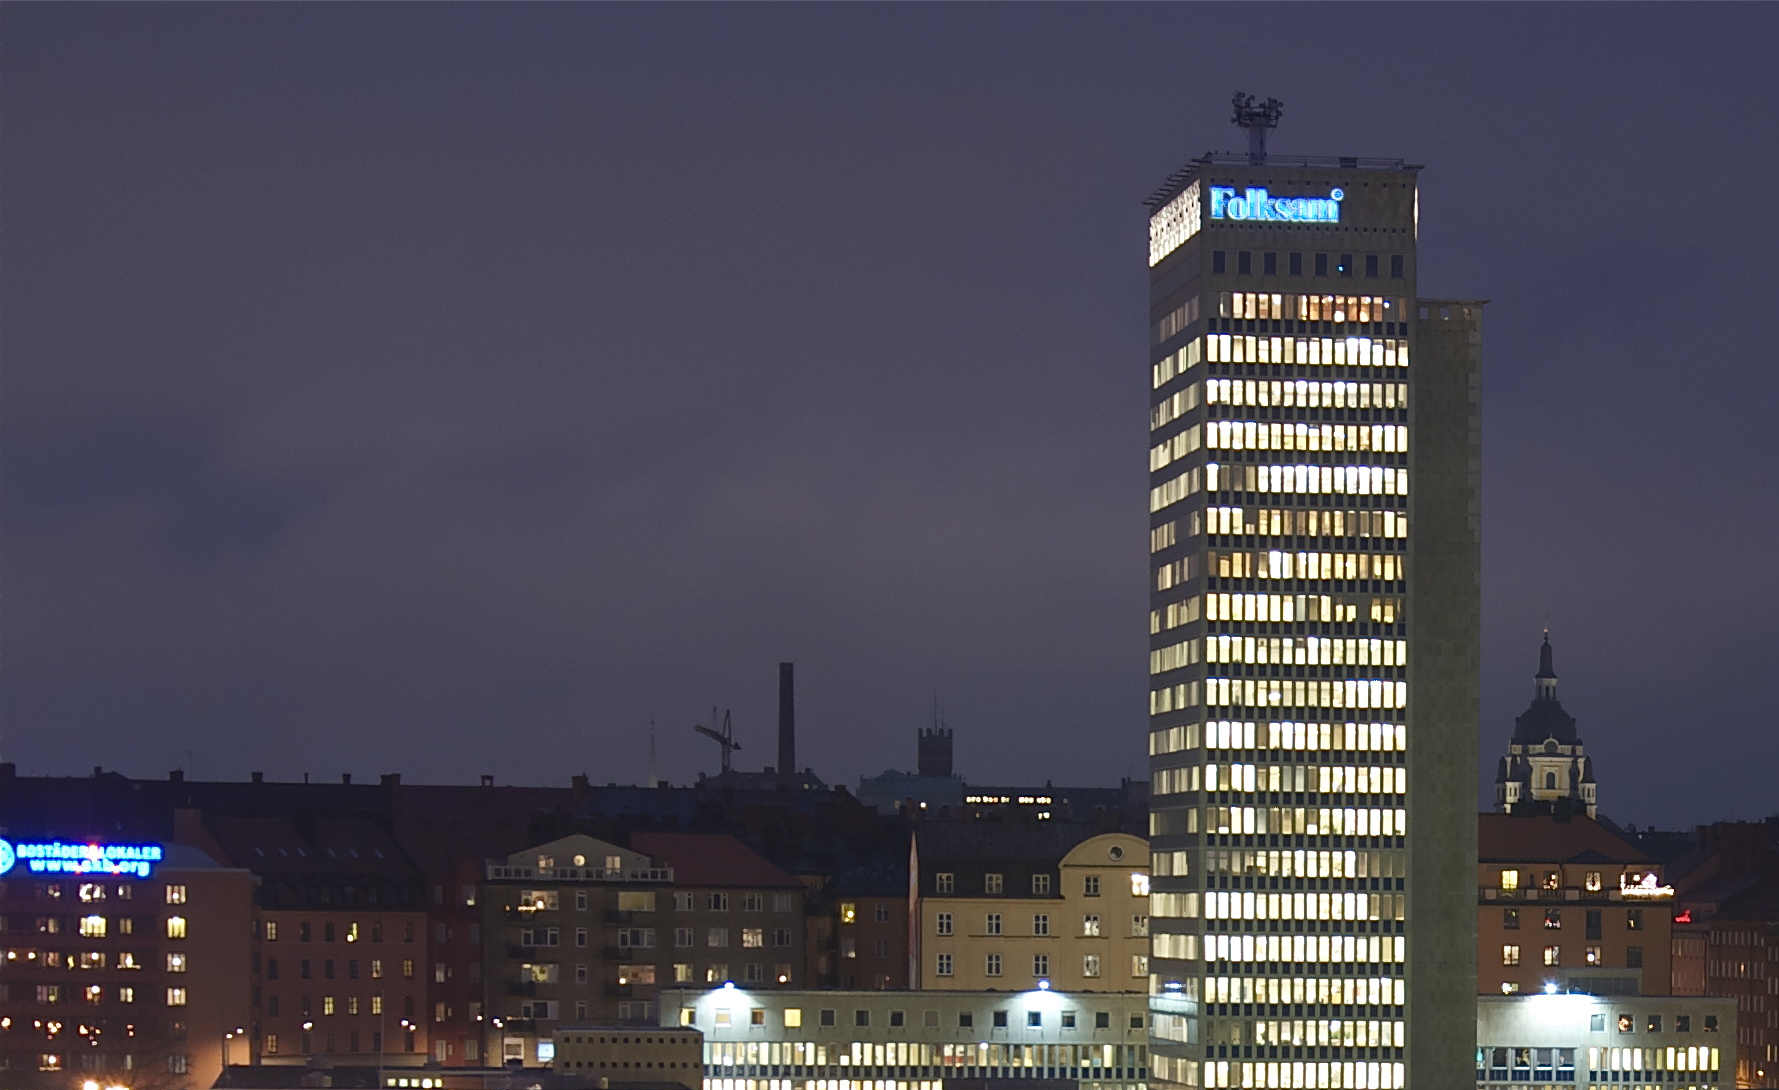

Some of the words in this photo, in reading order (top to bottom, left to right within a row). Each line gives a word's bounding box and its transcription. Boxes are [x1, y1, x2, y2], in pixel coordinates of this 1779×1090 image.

[1210, 187, 1340, 222] Folksam
[16, 842, 88, 859] BOSTÄDER
[99, 845, 162, 860] LOKALER
